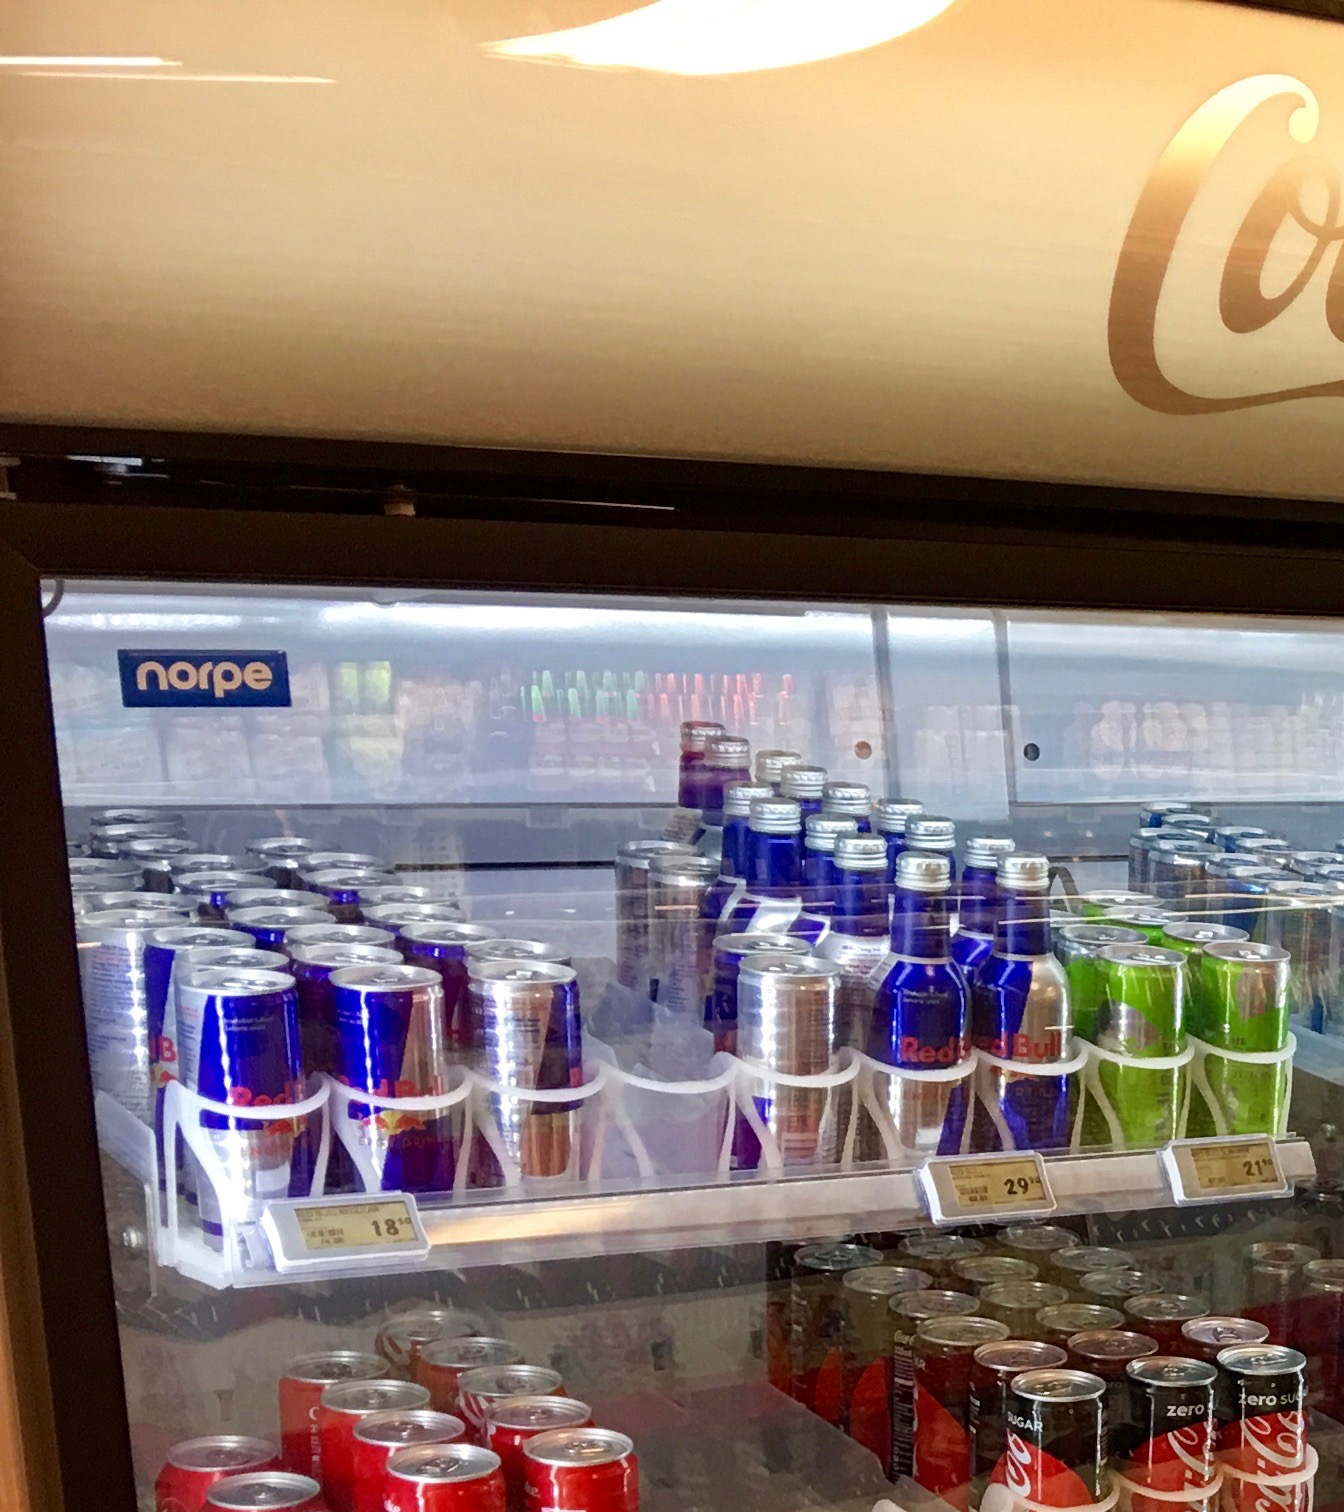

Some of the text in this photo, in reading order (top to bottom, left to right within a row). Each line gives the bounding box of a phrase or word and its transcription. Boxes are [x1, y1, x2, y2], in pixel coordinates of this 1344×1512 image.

[136, 659, 274, 697] norpe
[901, 1036, 954, 1064] Red
[1012, 1031, 1062, 1059] Bull
[1167, 1403, 1204, 1418] zero
[1239, 1393, 1277, 1407] zero
